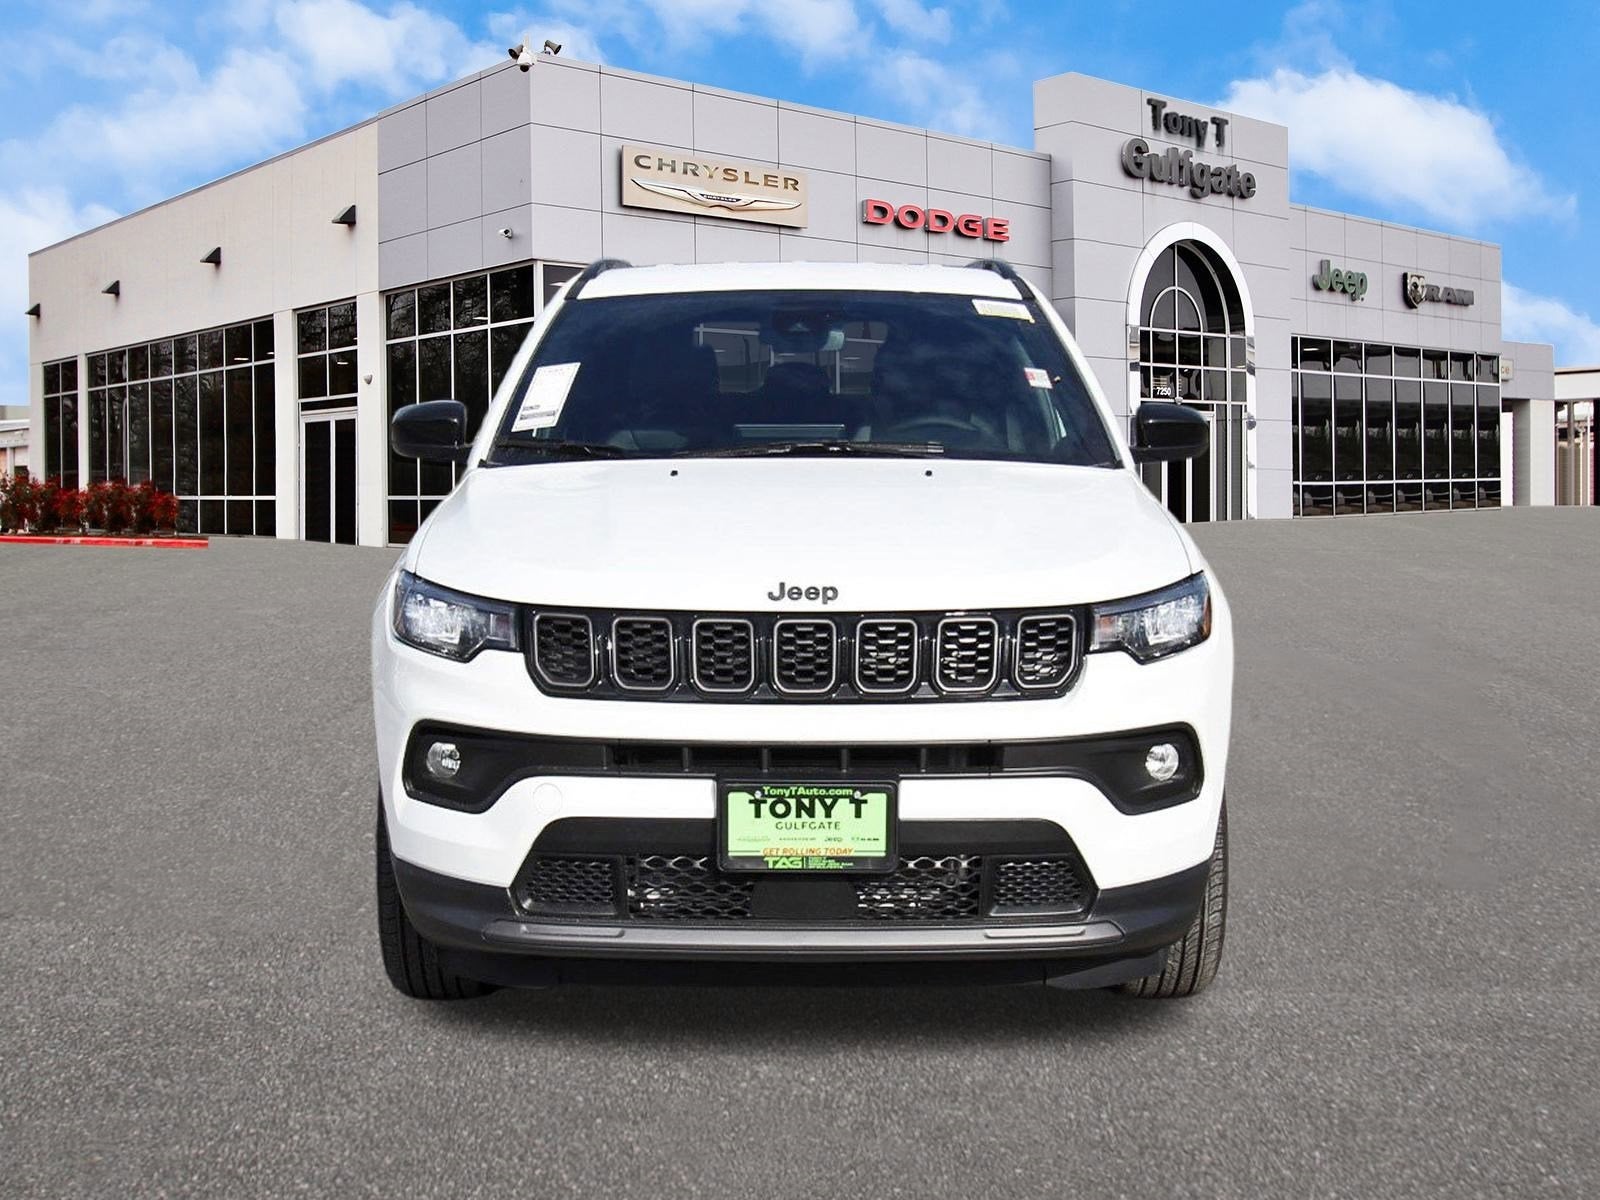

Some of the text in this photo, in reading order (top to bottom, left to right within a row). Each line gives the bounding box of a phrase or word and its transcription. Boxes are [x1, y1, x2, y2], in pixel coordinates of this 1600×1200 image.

[1147, 98, 1229, 147] Tony T
[633, 154, 800, 192] CHRYSLER
[1121, 138, 1257, 199] Gulfgate
[863, 199, 1011, 242] DODGE
[1312, 259, 1368, 301] Jeep
[1424, 284, 1475, 306] RAM
[767, 582, 839, 605] Jeep
[763, 786, 854, 798] TonyTAuto.com
[749, 797, 868, 819] TONY T
[775, 821, 841, 831] GULFGATE
[762, 847, 854, 856] GET ROLLING TODAY
[763, 856, 802, 869] TAG
